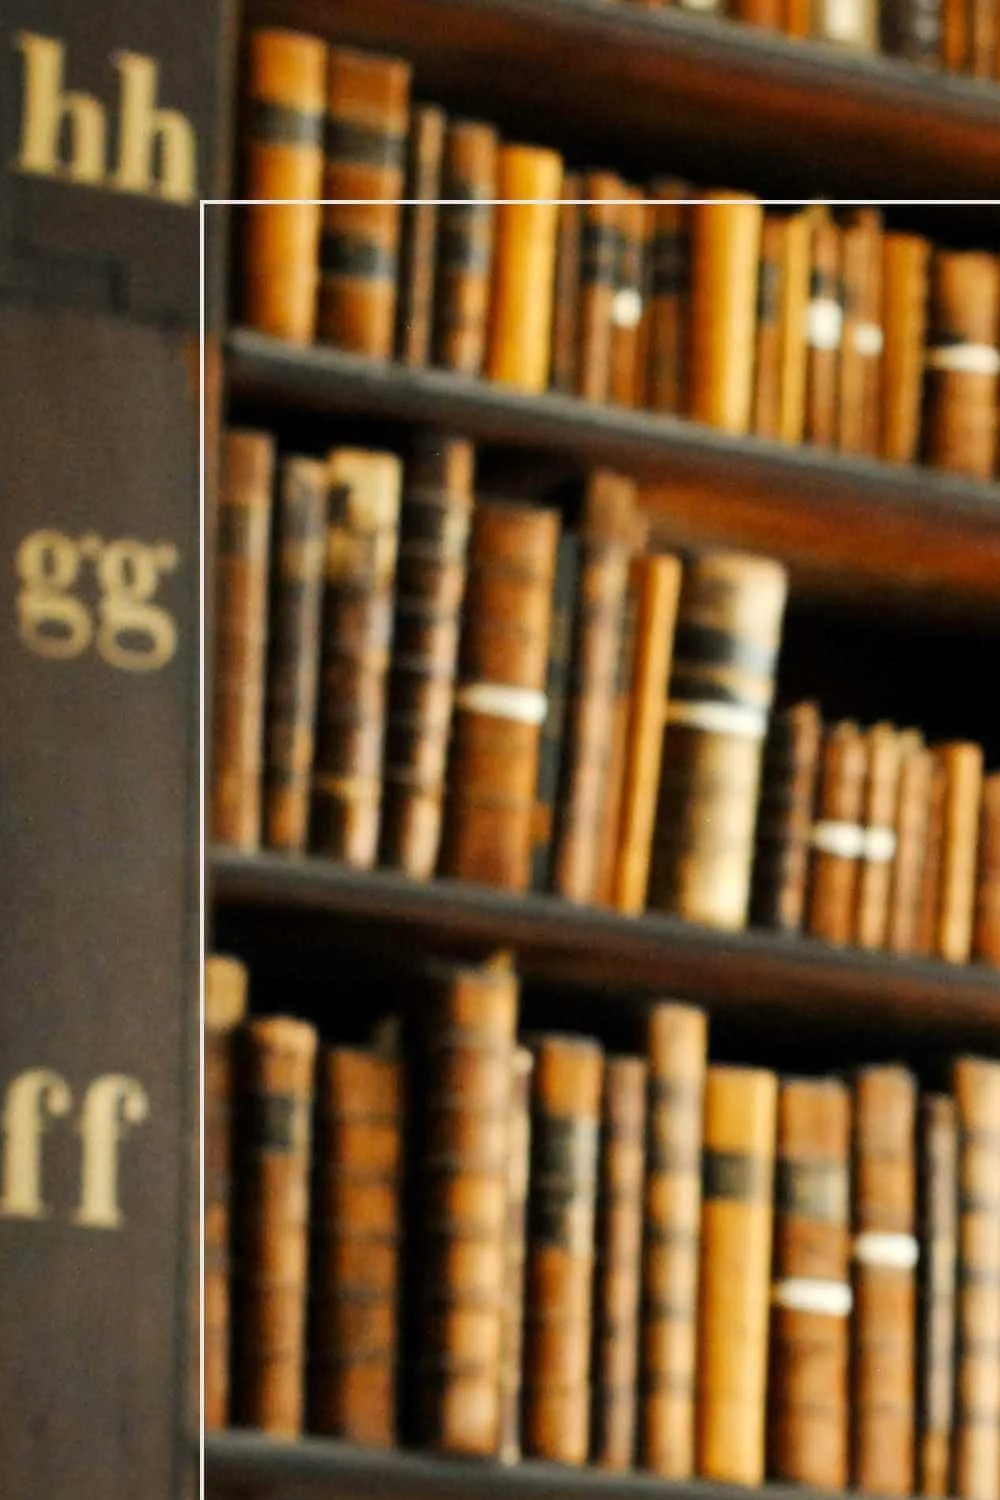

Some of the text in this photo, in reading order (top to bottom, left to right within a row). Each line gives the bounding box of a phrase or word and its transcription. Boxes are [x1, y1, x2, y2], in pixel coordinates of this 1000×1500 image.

[16, 31, 197, 204] hh
[17, 529, 178, 671] gg
[0, 1067, 149, 1230] ff
